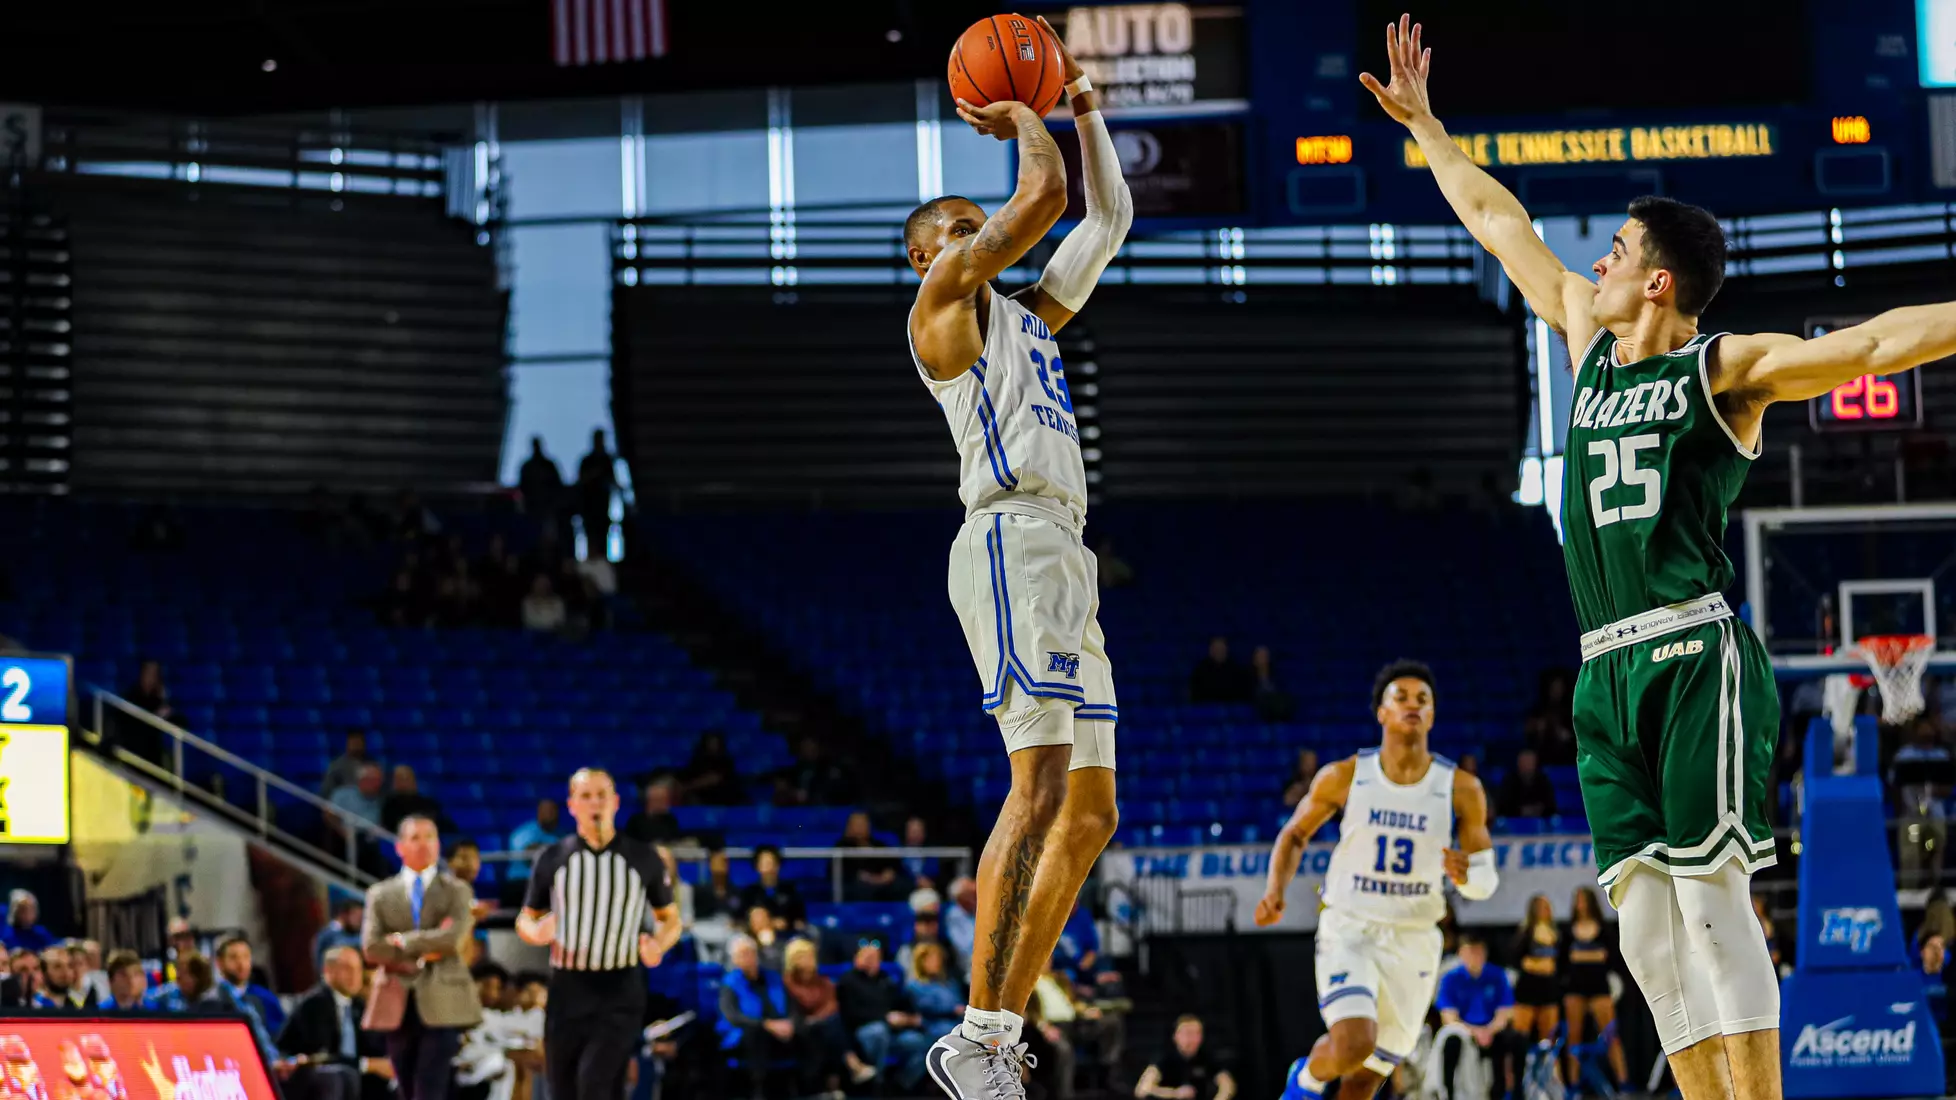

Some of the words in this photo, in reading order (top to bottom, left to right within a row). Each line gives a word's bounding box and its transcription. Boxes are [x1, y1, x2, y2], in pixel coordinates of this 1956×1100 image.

[1010, 19, 1035, 61] ELITE
[1065, 4, 1192, 54] AUTO
[1496, 128, 1626, 165] TENNESSEE
[1630, 123, 1772, 160] BASKETBALL
[1029, 348, 1074, 415] 23
[1832, 373, 1899, 420] 26
[1572, 375, 1690, 430] BLAZERS
[1588, 433, 1661, 529] 25
[1640, 615, 1675, 631] ARMOUR
[1676, 606, 1708, 620] UNDER
[1046, 651, 1080, 679] MT
[1652, 639, 1704, 663] UAB
[1368, 808, 1428, 832] MIDDLE
[1374, 835, 1415, 875] 13
[1791, 1019, 1917, 1058] Ascend
